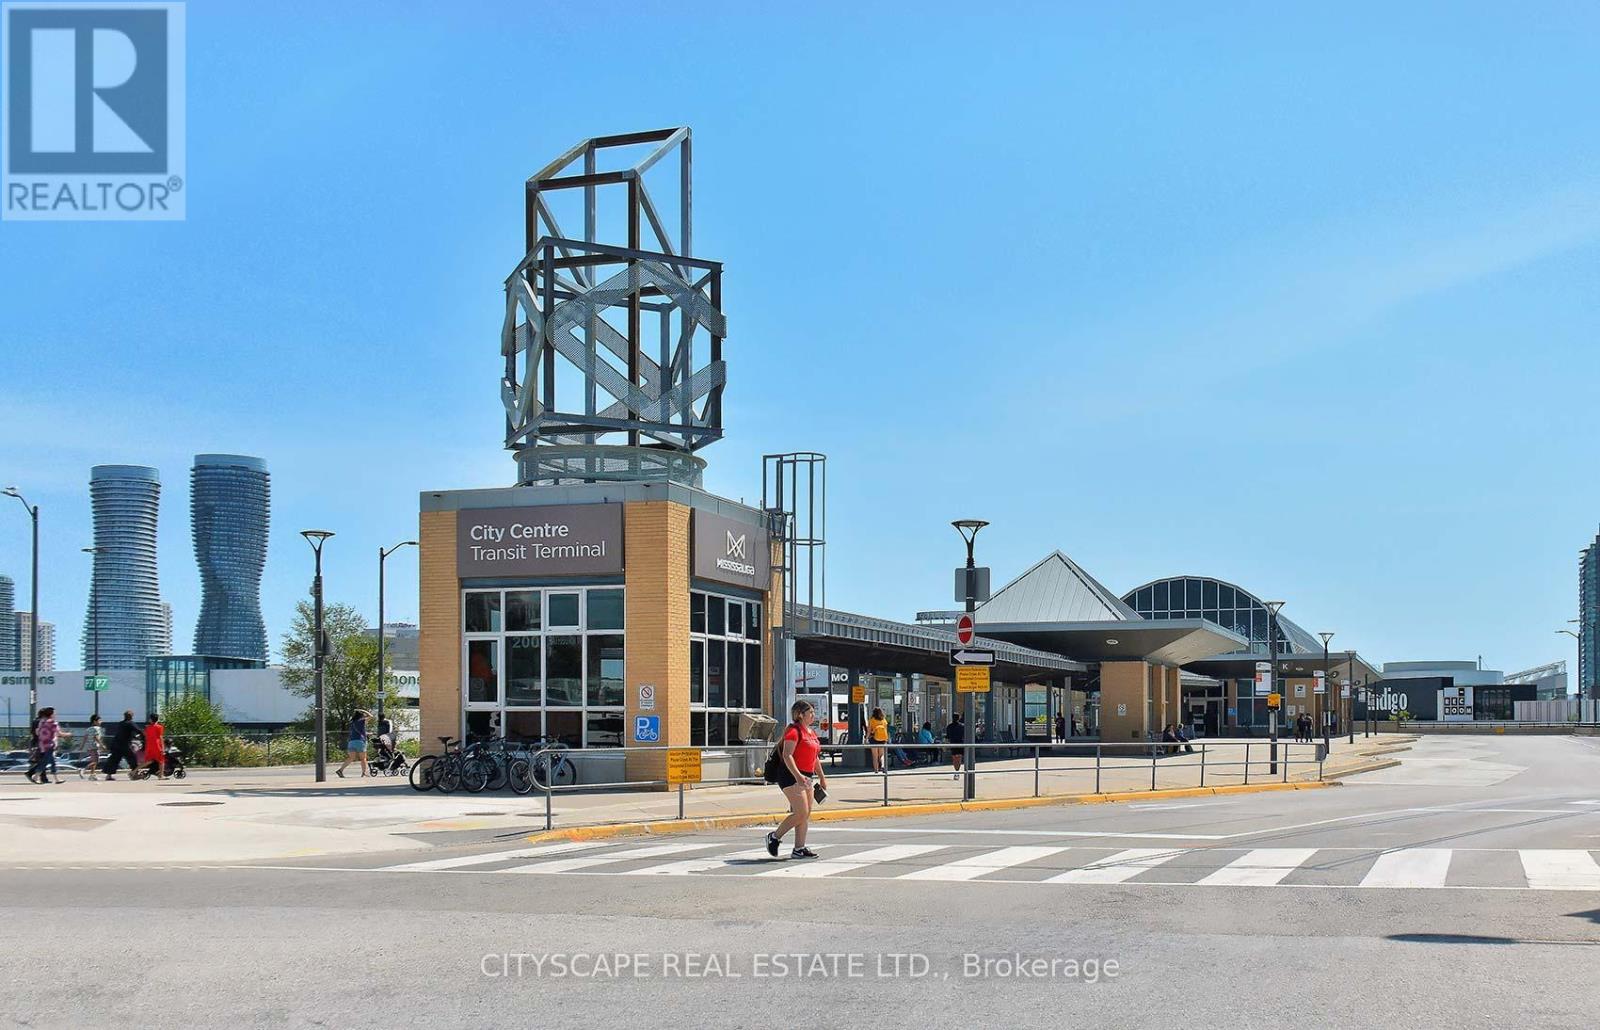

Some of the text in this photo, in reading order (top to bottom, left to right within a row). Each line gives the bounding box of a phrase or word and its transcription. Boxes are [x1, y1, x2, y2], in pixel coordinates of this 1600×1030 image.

[470, 523, 569, 543] City Centre
[470, 540, 606, 561] Transit Terminal
[511, 636, 540, 649] 200
[1367, 687, 1408, 714] ndigo
